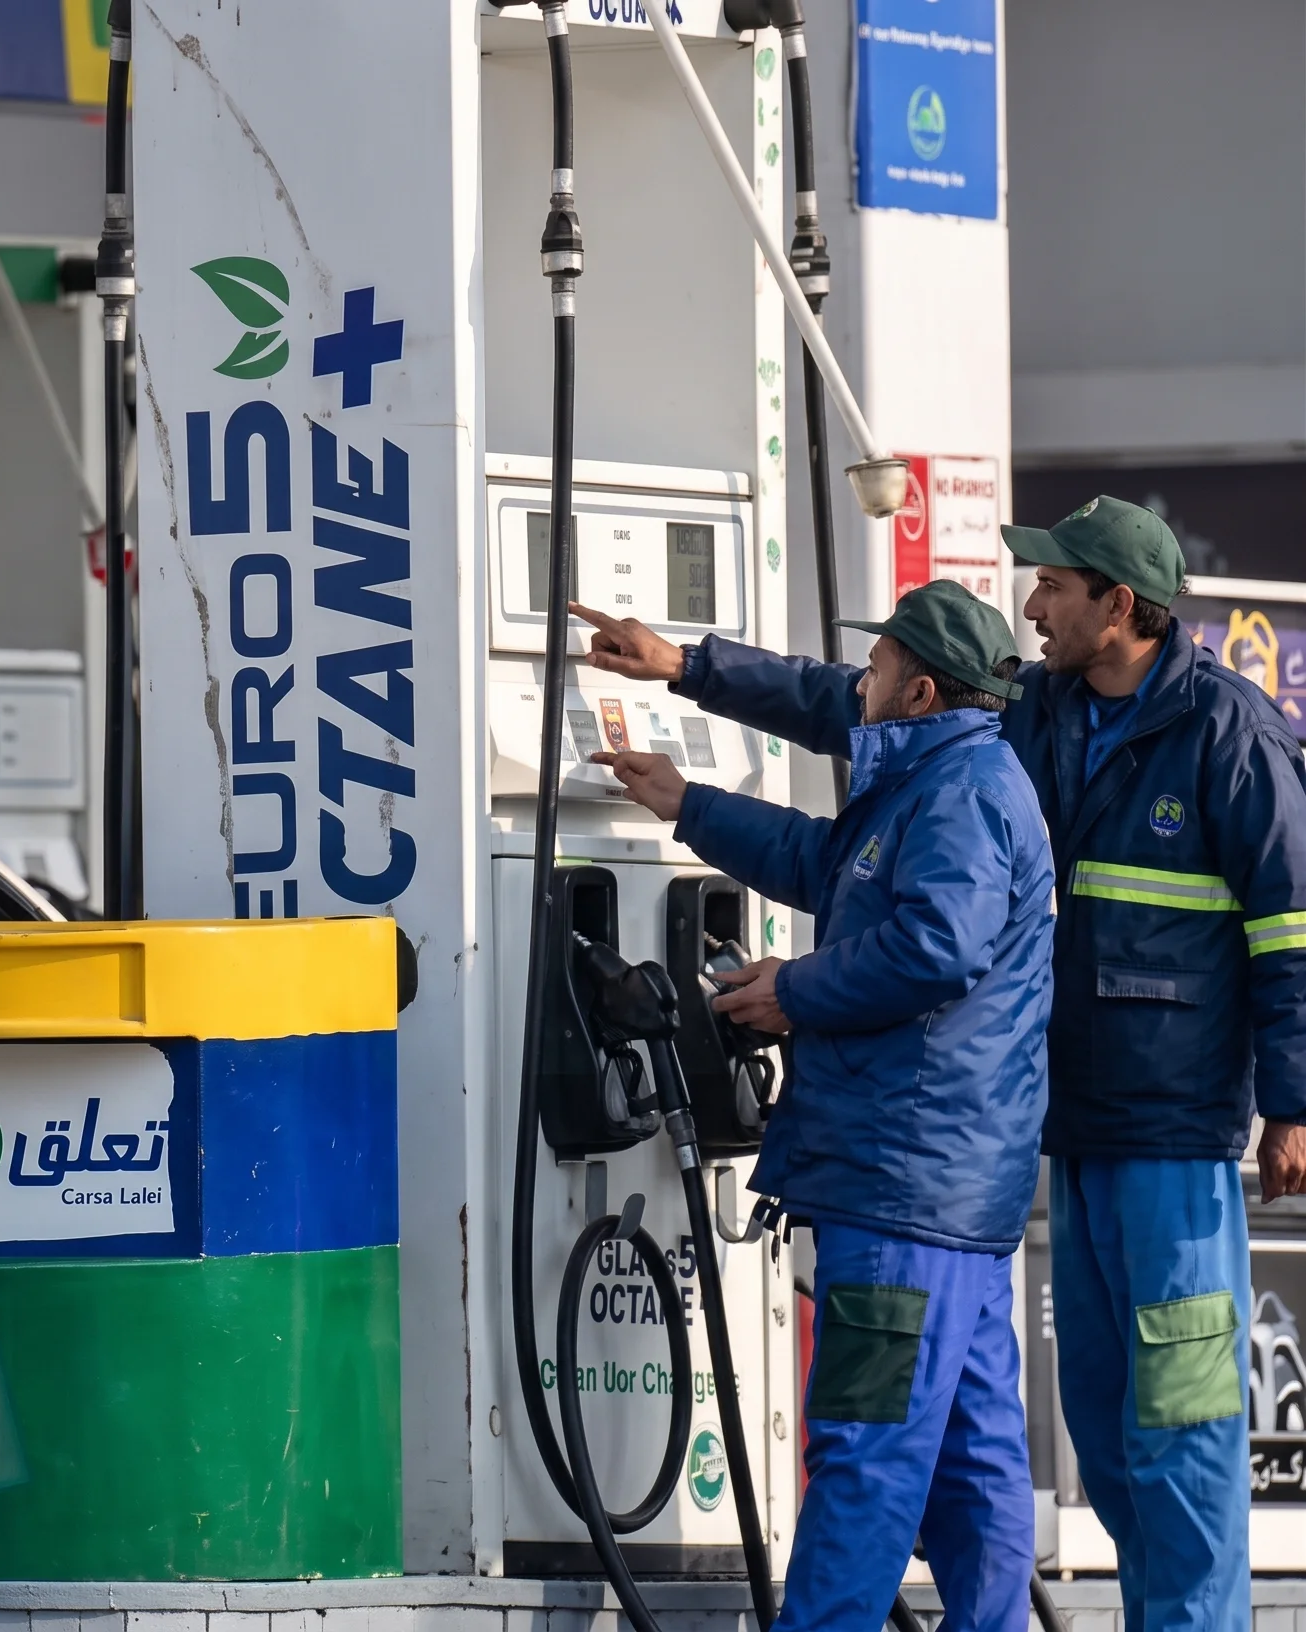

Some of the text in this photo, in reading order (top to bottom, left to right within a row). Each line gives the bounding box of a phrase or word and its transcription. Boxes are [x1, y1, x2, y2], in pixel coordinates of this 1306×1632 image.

[8, 1097, 170, 1187] تعلق
[61, 1187, 162, 1205] Carsa Lalei
[590, 1282, 694, 1326] OCTAE
